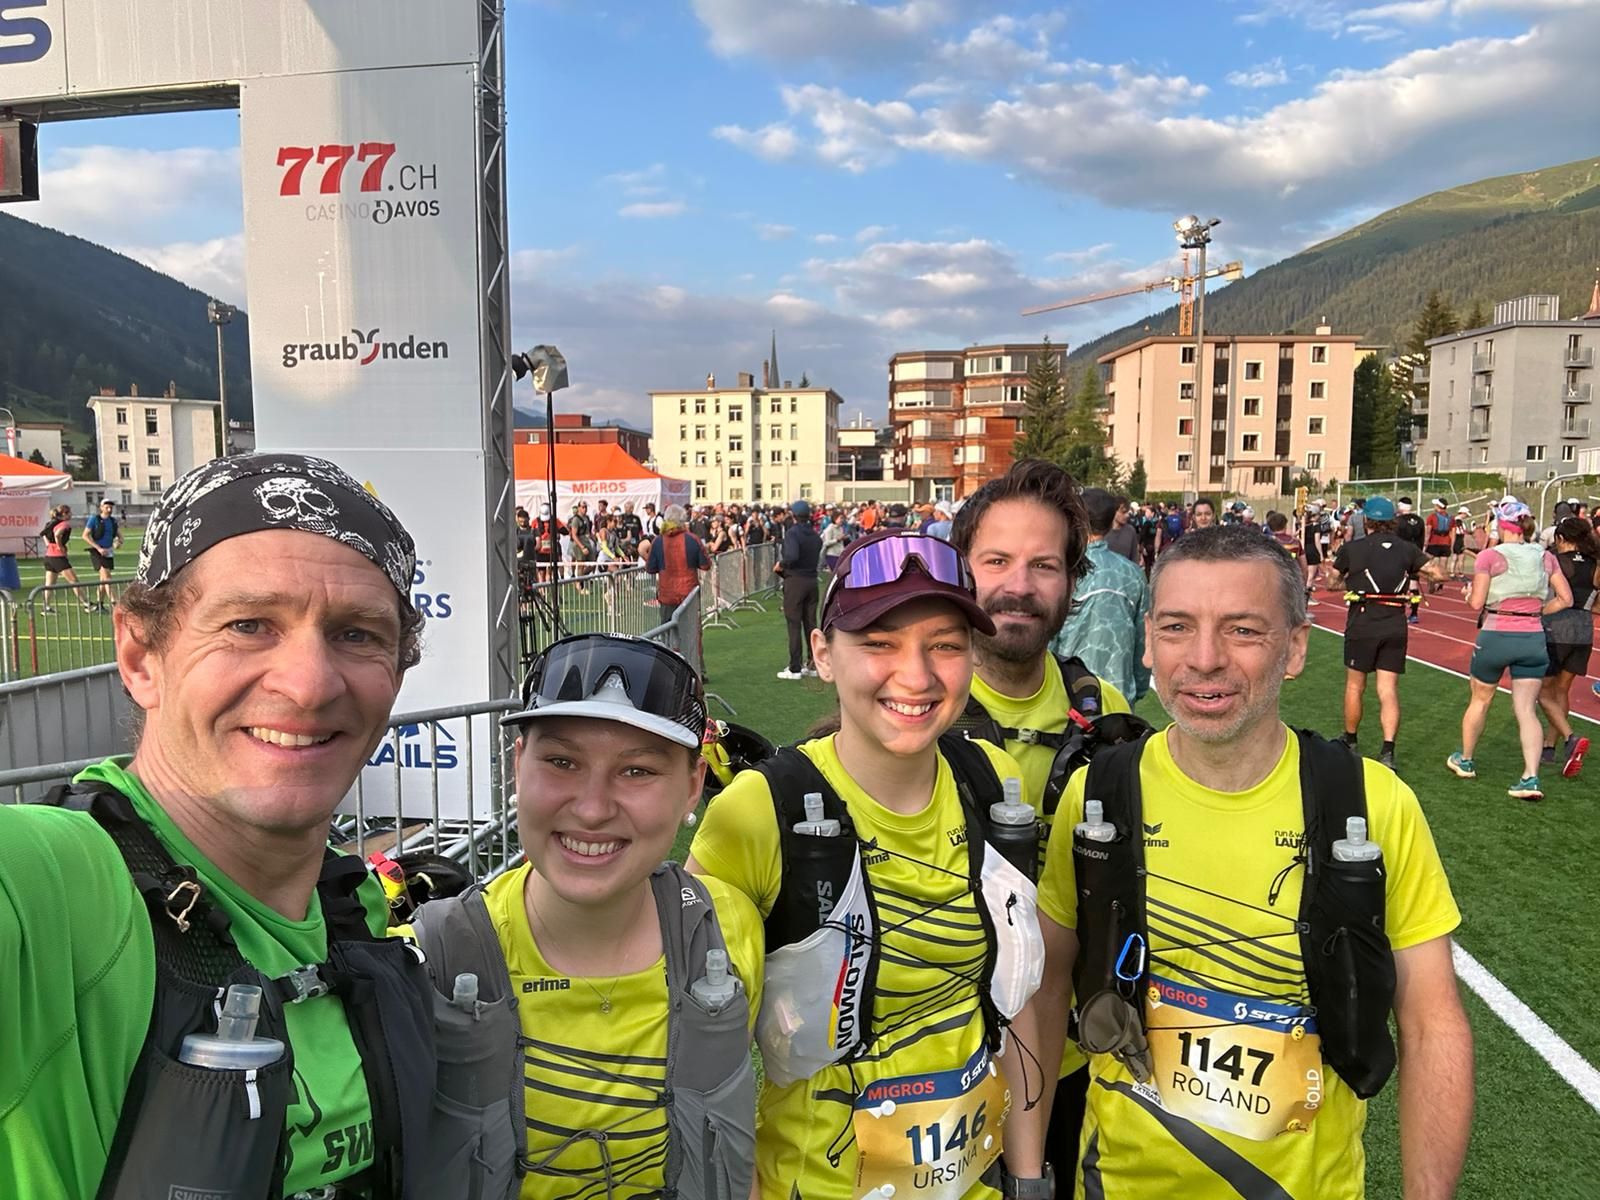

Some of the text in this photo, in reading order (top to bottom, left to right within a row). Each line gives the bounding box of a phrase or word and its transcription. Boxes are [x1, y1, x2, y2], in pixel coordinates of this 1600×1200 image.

[277, 142, 437, 196] 777.CH
[572, 482, 627, 494] MIGROS
[366, 743, 458, 769] AILS
[522, 978, 571, 993] erima
[836, 914, 866, 1050] SALOMON
[1178, 1031, 1274, 1087] 1147
[867, 1081, 935, 1100] MIGROS
[1172, 1071, 1271, 1115] ROLAND
[1304, 1069, 1321, 1110] GOLD
[906, 1100, 987, 1166] 1146
[913, 1145, 978, 1189] URSINA
